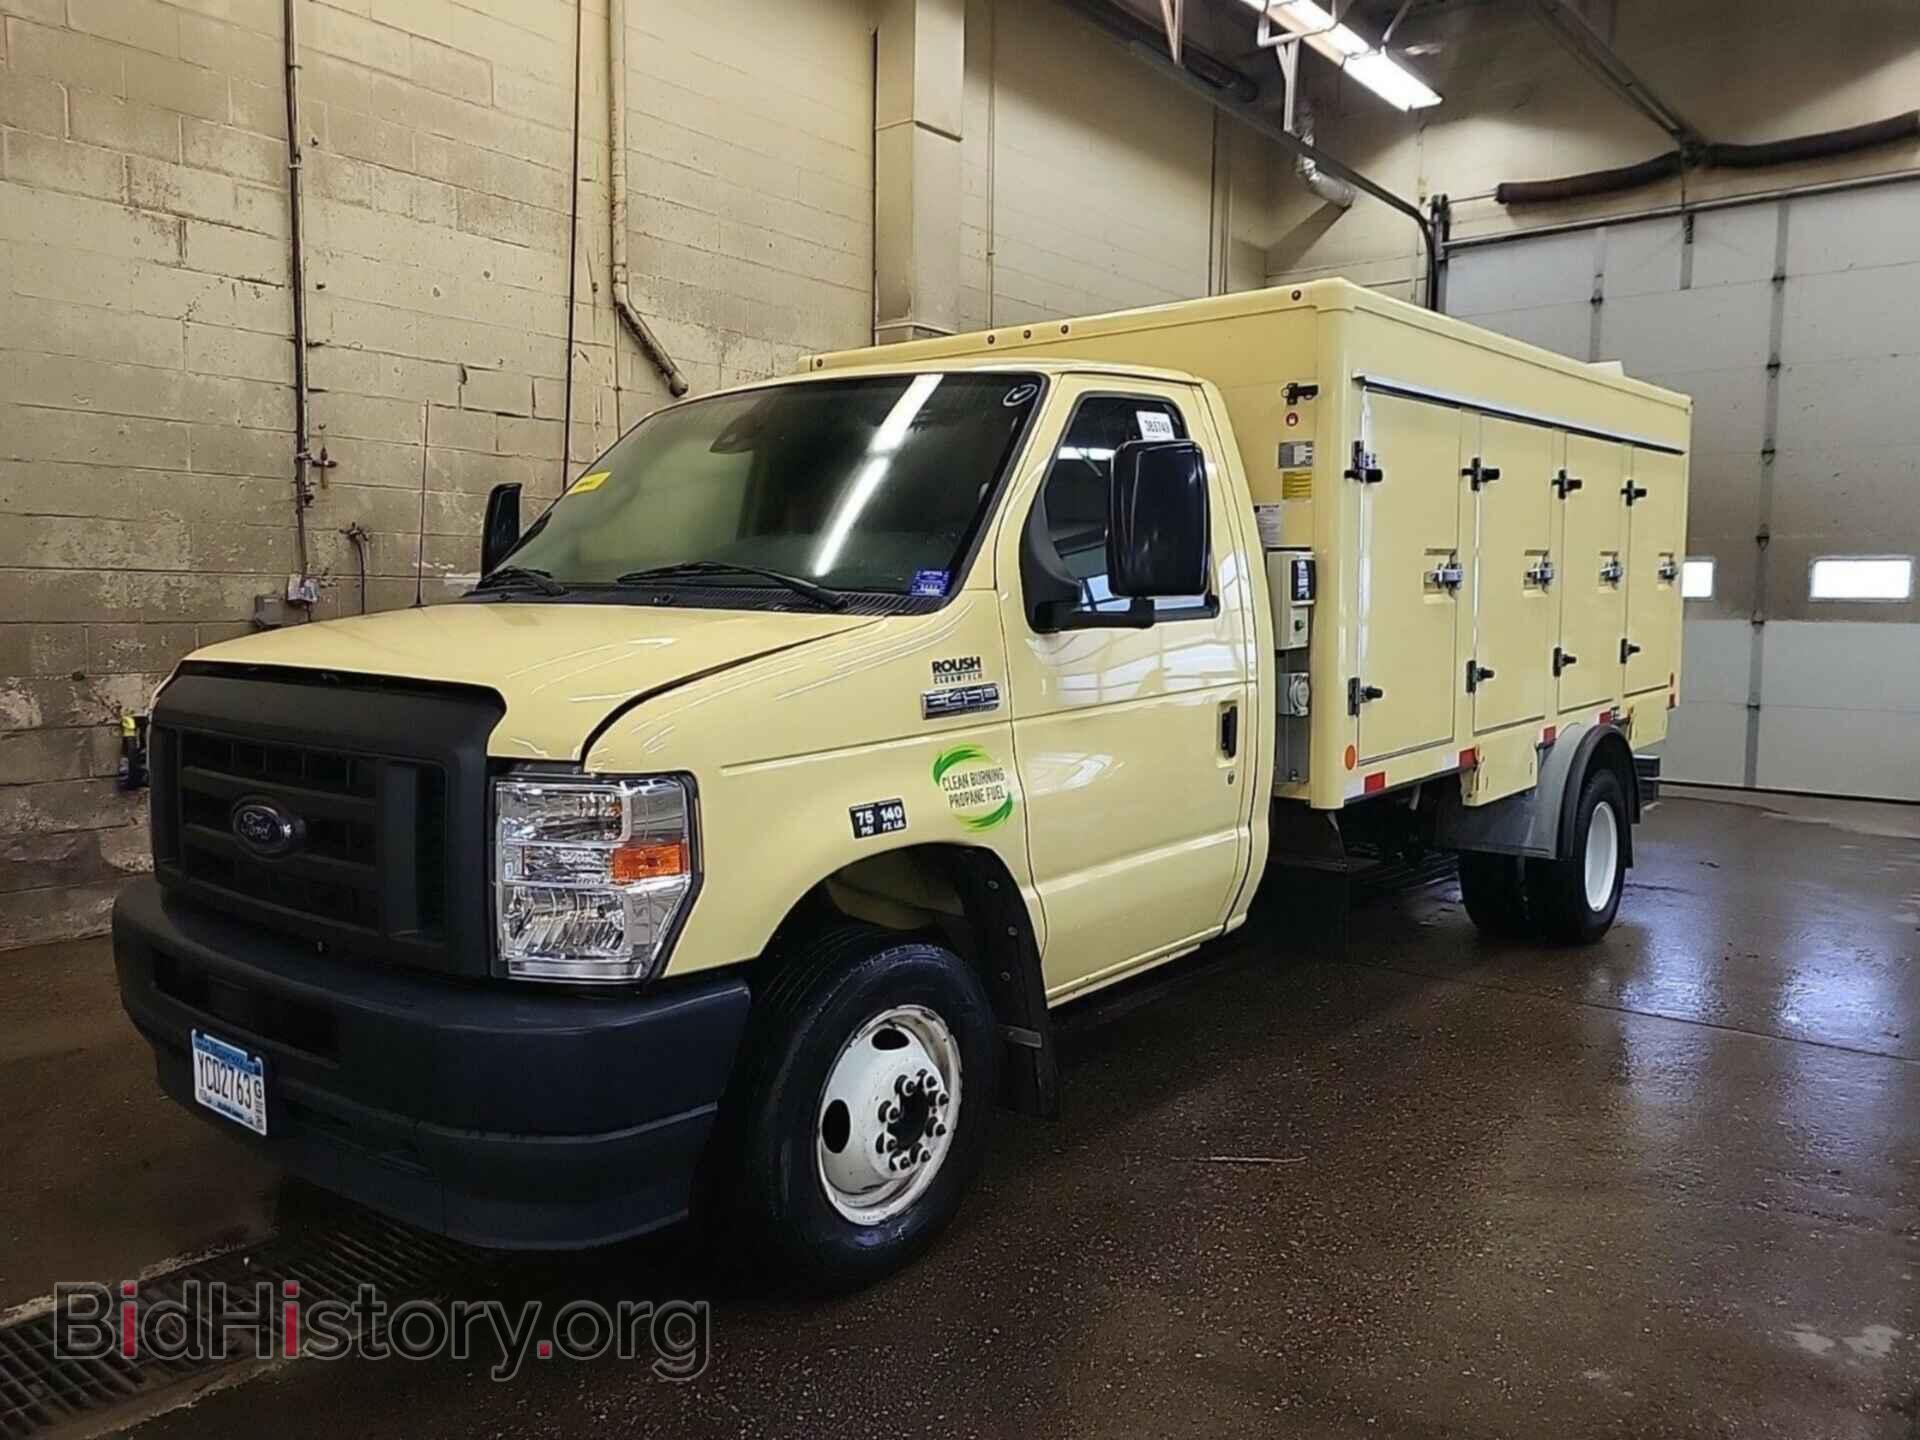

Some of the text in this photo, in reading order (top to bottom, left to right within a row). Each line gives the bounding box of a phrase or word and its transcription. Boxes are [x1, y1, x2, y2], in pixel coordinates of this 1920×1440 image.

[931, 656, 981, 673] ROUSH
[942, 767, 1005, 791] CLEAN BURNING
[948, 785, 1005, 808] PROPANE FUEL
[855, 810, 875, 826] 75
[880, 805, 903, 822] 140
[243, 812, 272, 841] Ford
